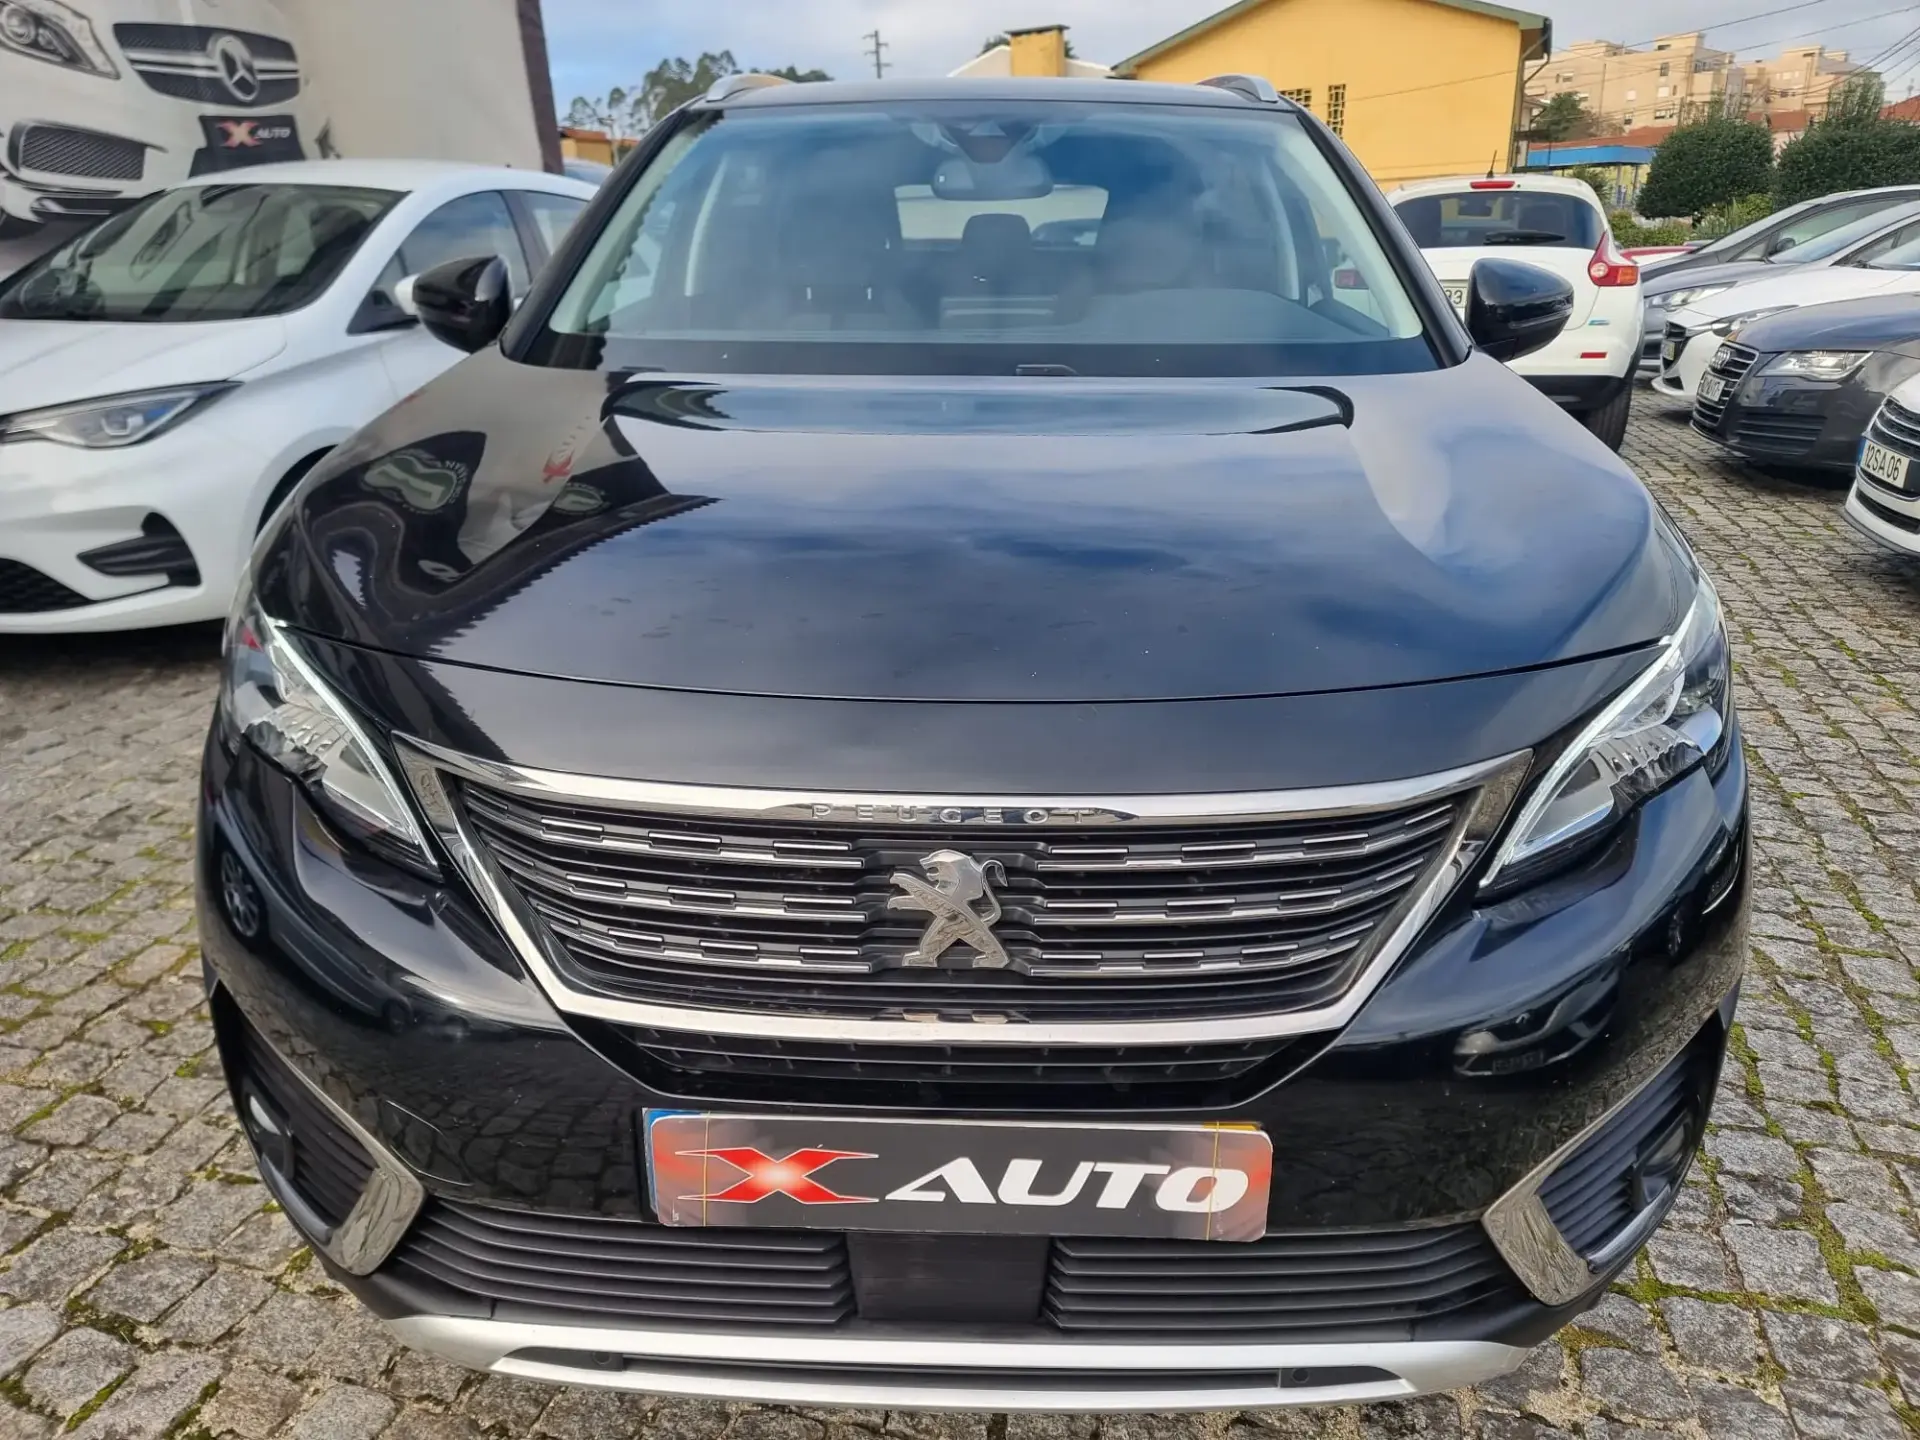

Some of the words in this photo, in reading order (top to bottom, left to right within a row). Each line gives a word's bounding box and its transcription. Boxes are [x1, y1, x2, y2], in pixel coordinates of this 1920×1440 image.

[217, 121, 262, 148] X
[255, 127, 292, 139] AUTO
[812, 803, 1098, 824] PEUGEOT
[674, 1147, 879, 1204] X
[885, 1156, 1249, 1213] AUTO
